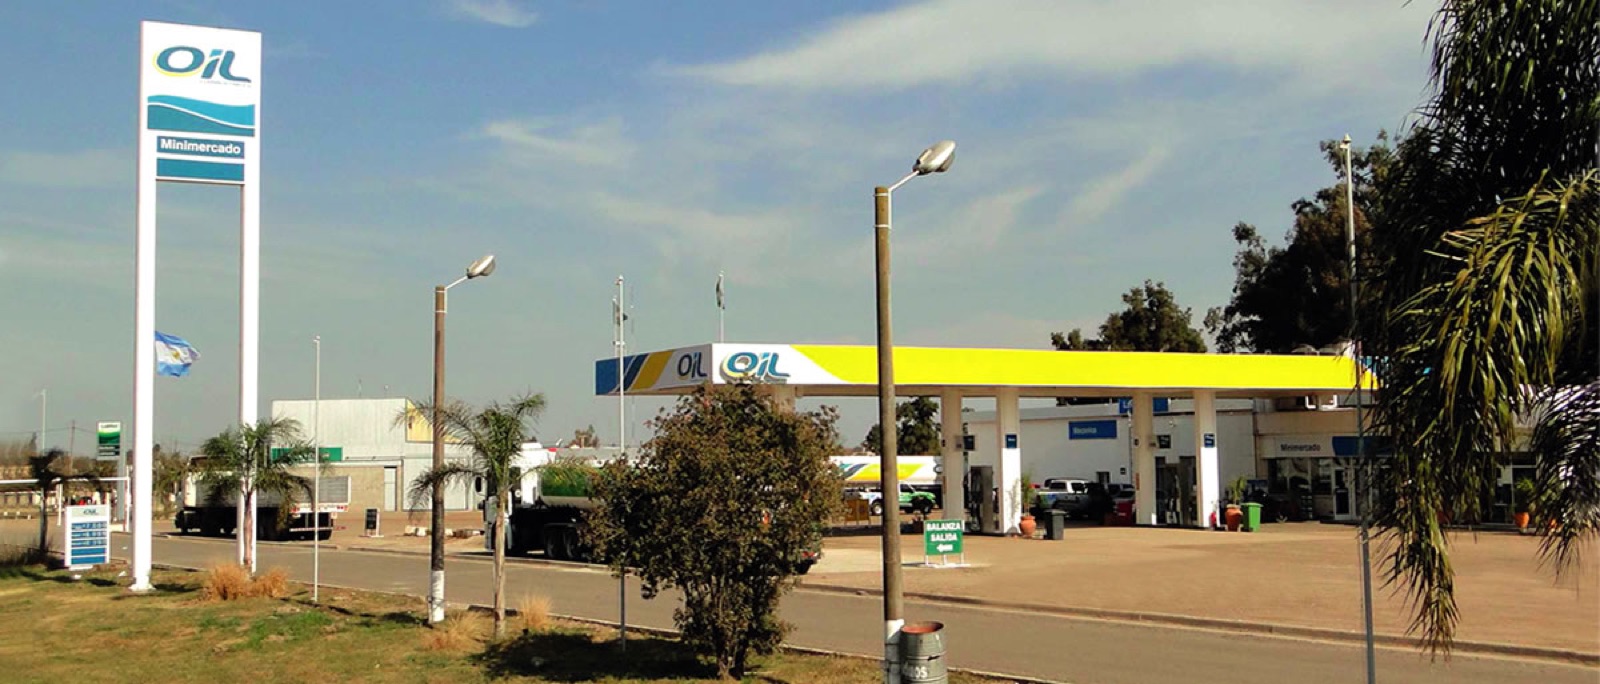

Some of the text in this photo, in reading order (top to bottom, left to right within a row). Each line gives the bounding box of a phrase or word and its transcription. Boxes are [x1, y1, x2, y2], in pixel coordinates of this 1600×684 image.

[160, 138, 242, 155] Minimercado
[1280, 443, 1321, 452] Minimercado
[926, 522, 961, 531] BALANZA
[930, 533, 958, 542] SALIDA
